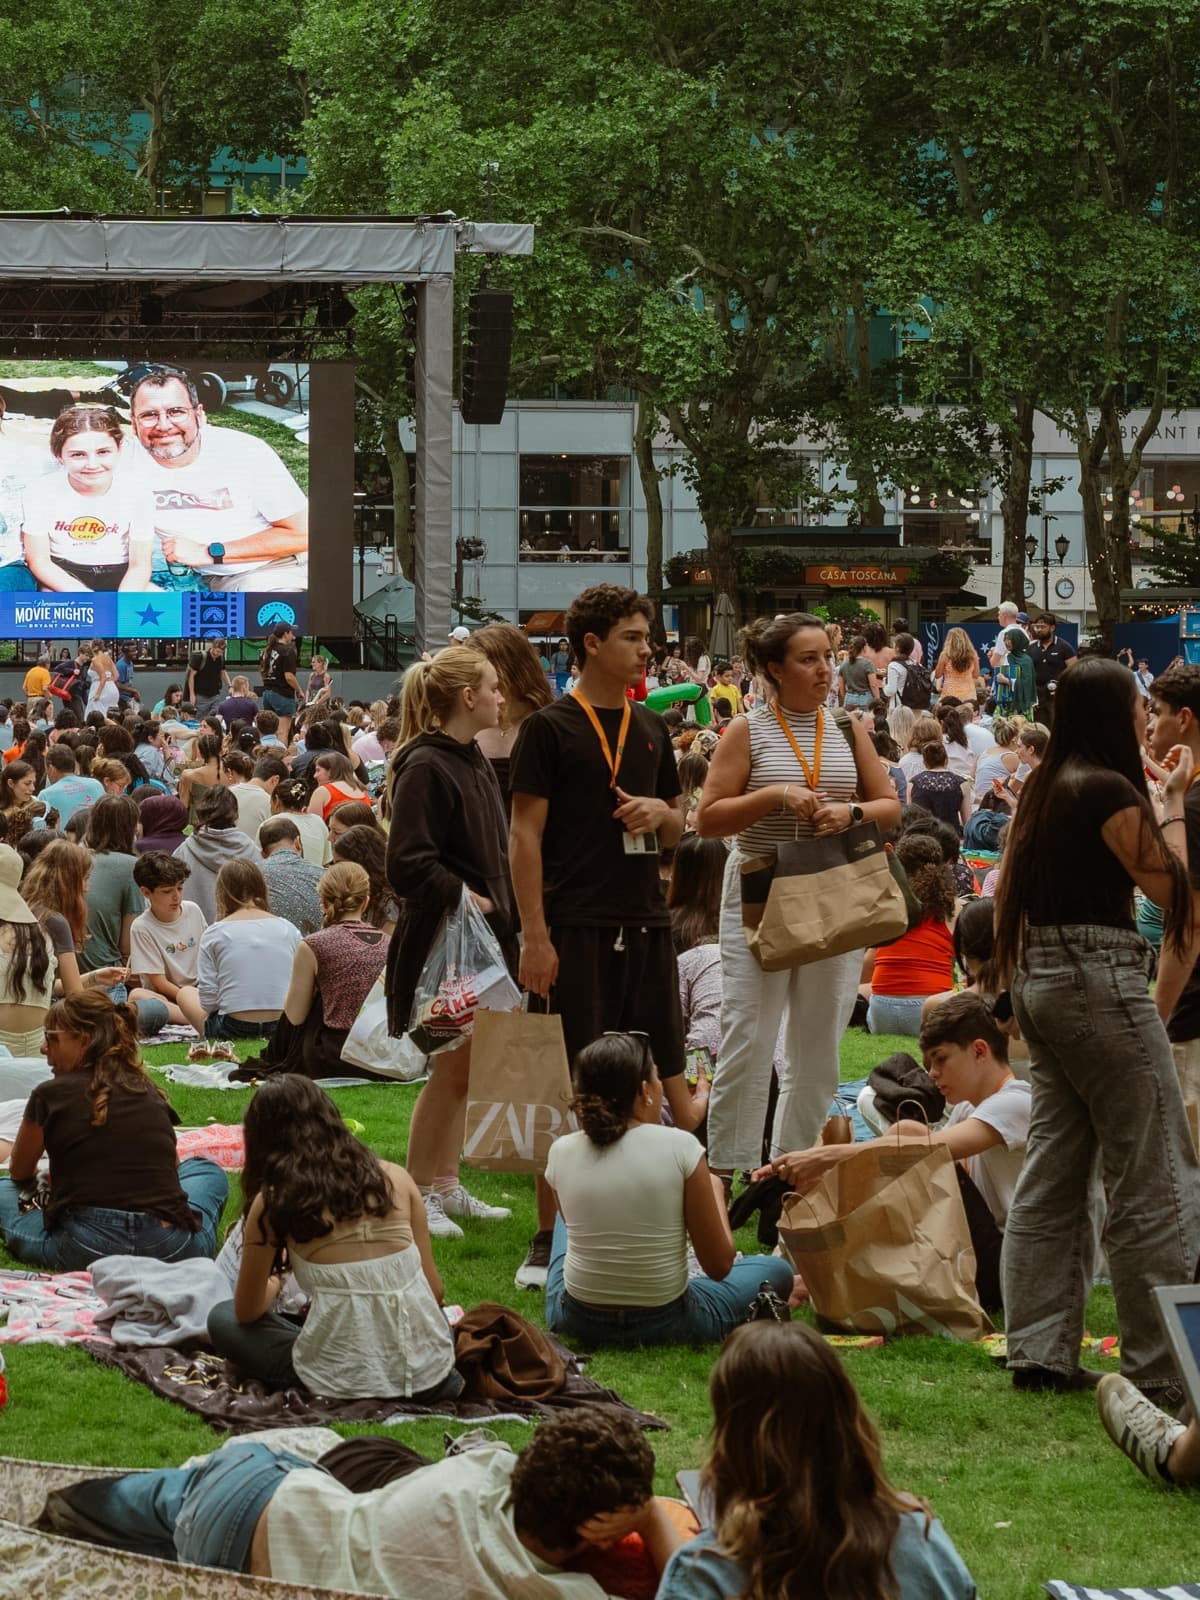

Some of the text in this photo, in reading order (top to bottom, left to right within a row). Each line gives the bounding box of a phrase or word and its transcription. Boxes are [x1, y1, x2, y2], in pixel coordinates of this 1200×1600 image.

[1120, 426, 1188, 440] BRANT
[54, 520, 119, 535] Hard Rock
[820, 571, 897, 581] CASA TOSCANA
[15, 607, 94, 624] MOVIE NIGHTS
[430, 991, 479, 1016] CAKE
